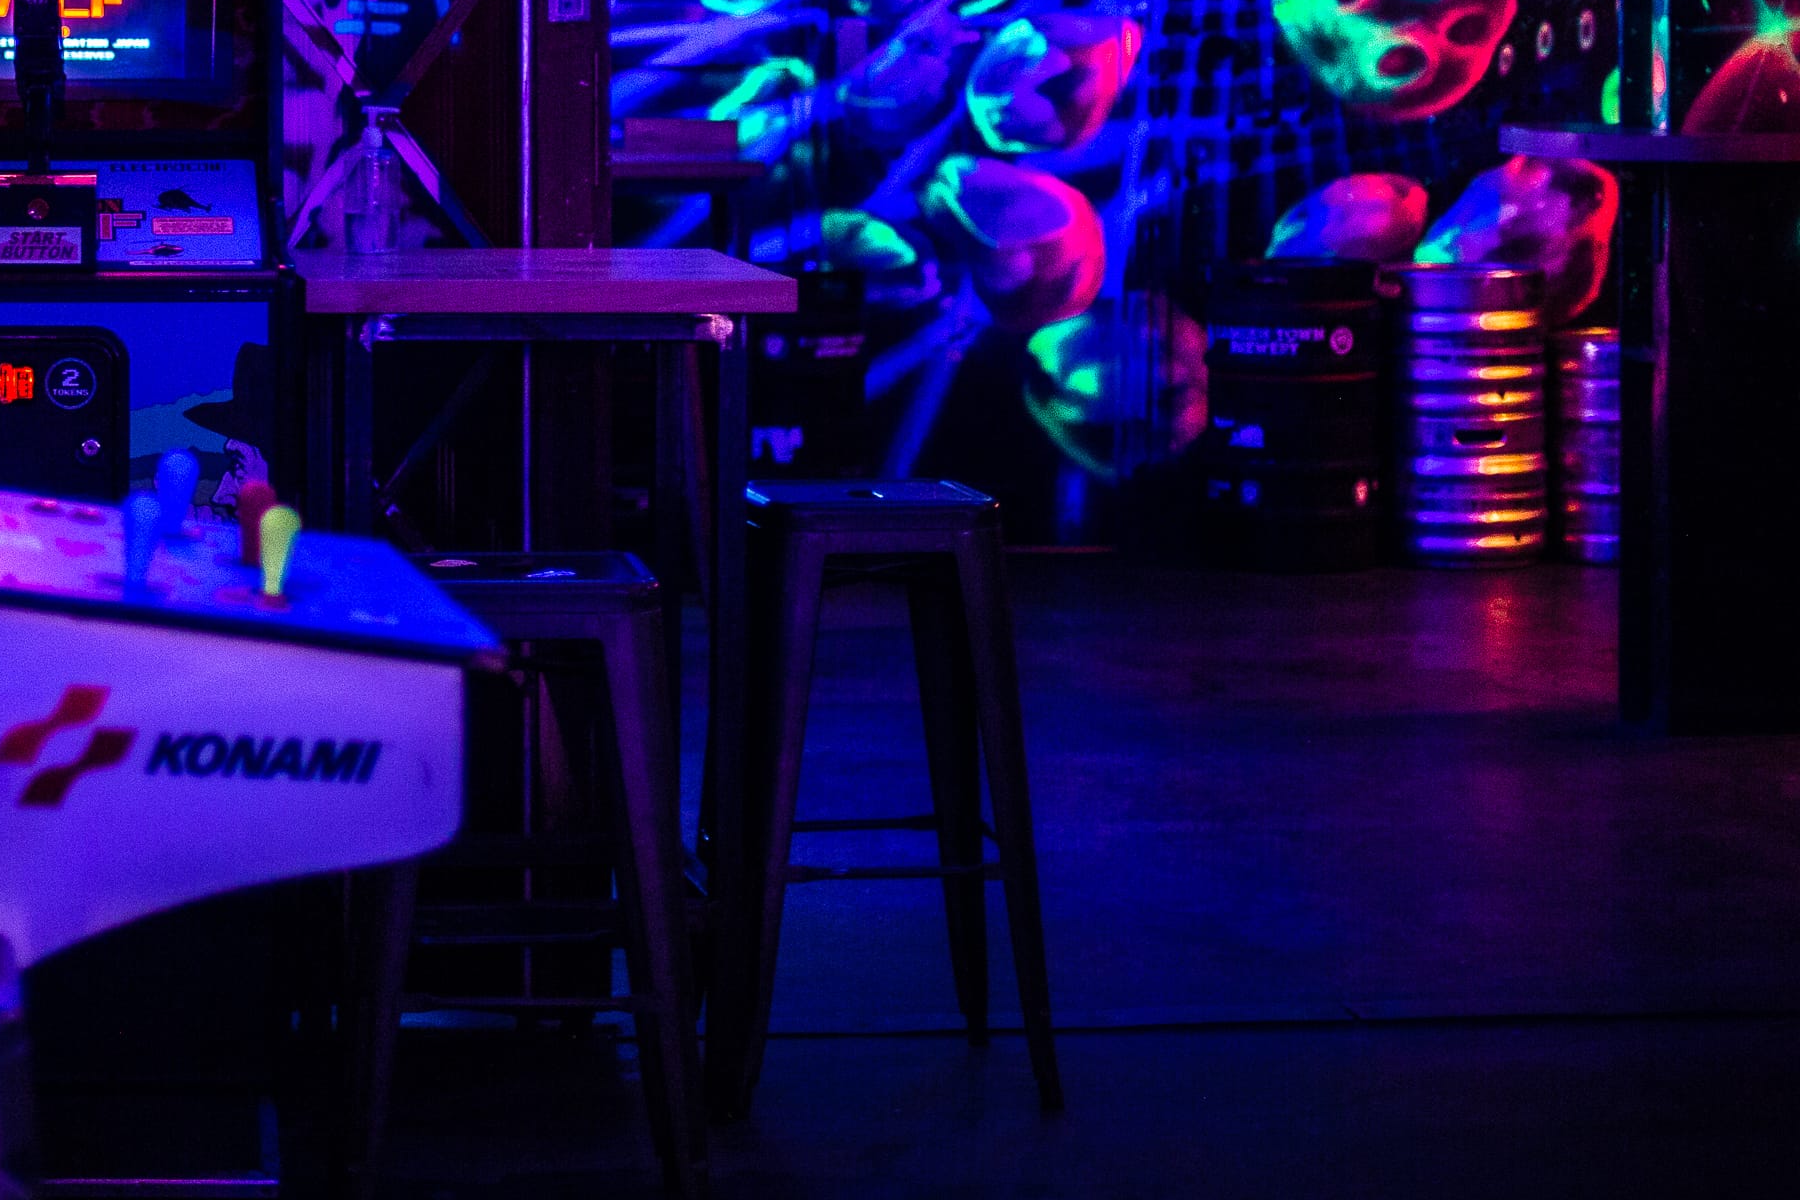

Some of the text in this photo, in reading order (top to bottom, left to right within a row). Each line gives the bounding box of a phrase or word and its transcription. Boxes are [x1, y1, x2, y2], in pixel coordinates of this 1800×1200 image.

[63, 50, 115, 60] ESERVED
[9, 231, 67, 245] START
[1, 245, 74, 260] BUTTON
[61, 368, 80, 387] 2
[52, 388, 89, 397] TOKENS
[145, 730, 384, 784] KONAMI
